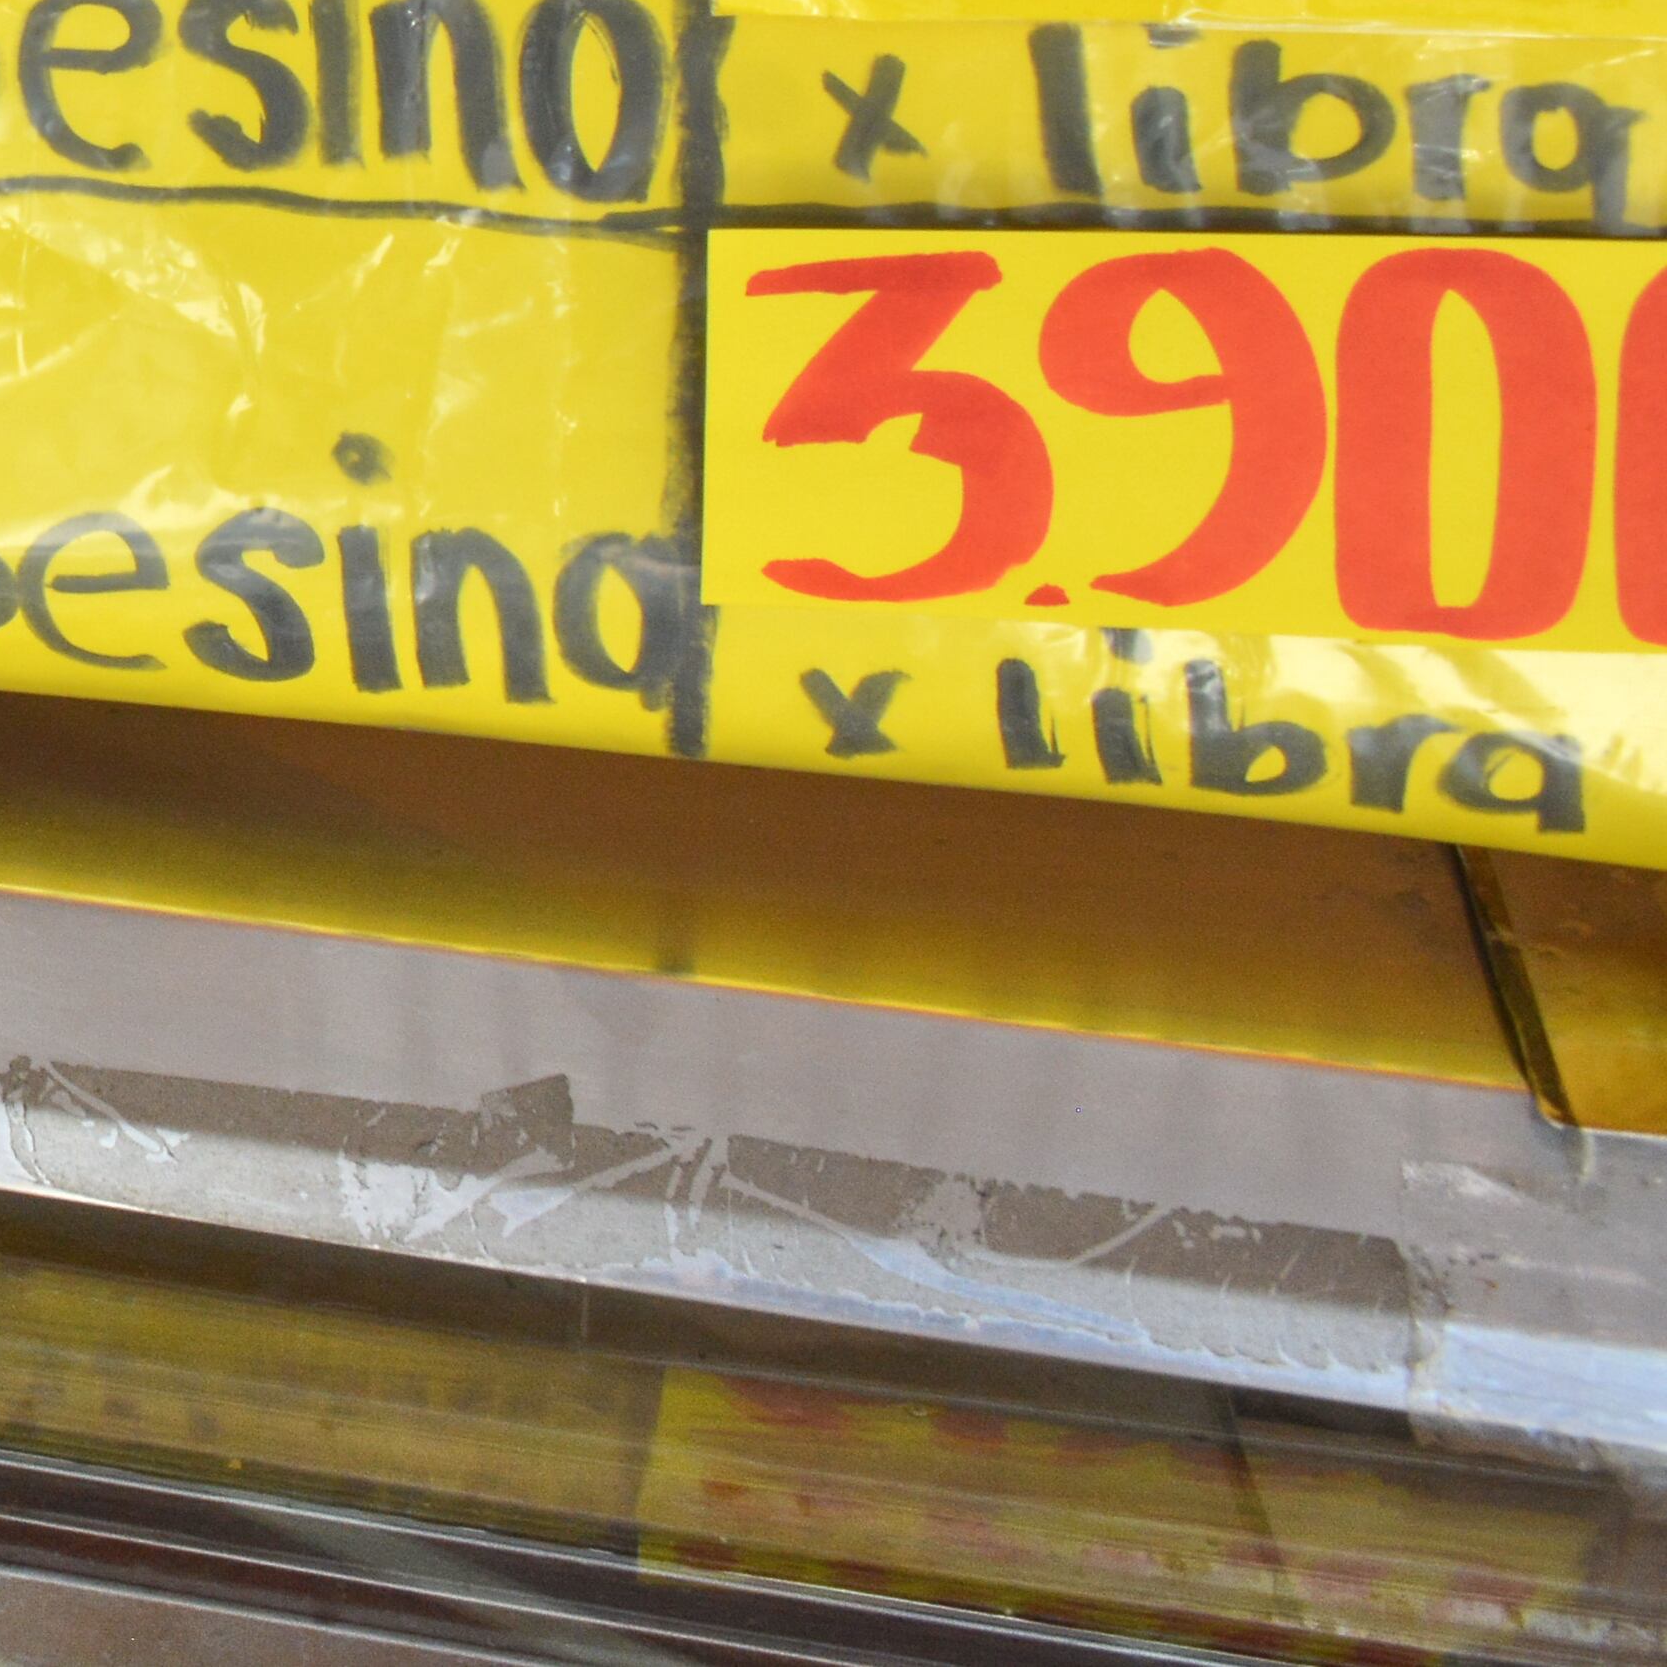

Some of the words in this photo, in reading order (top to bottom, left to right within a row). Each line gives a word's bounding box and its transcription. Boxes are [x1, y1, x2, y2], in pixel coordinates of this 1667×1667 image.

[820, 52, 928, 183] x
[1027, 22, 1647, 233] libra
[745, 246, 1667, 648] 3.90
[994, 626, 1587, 835] libra
